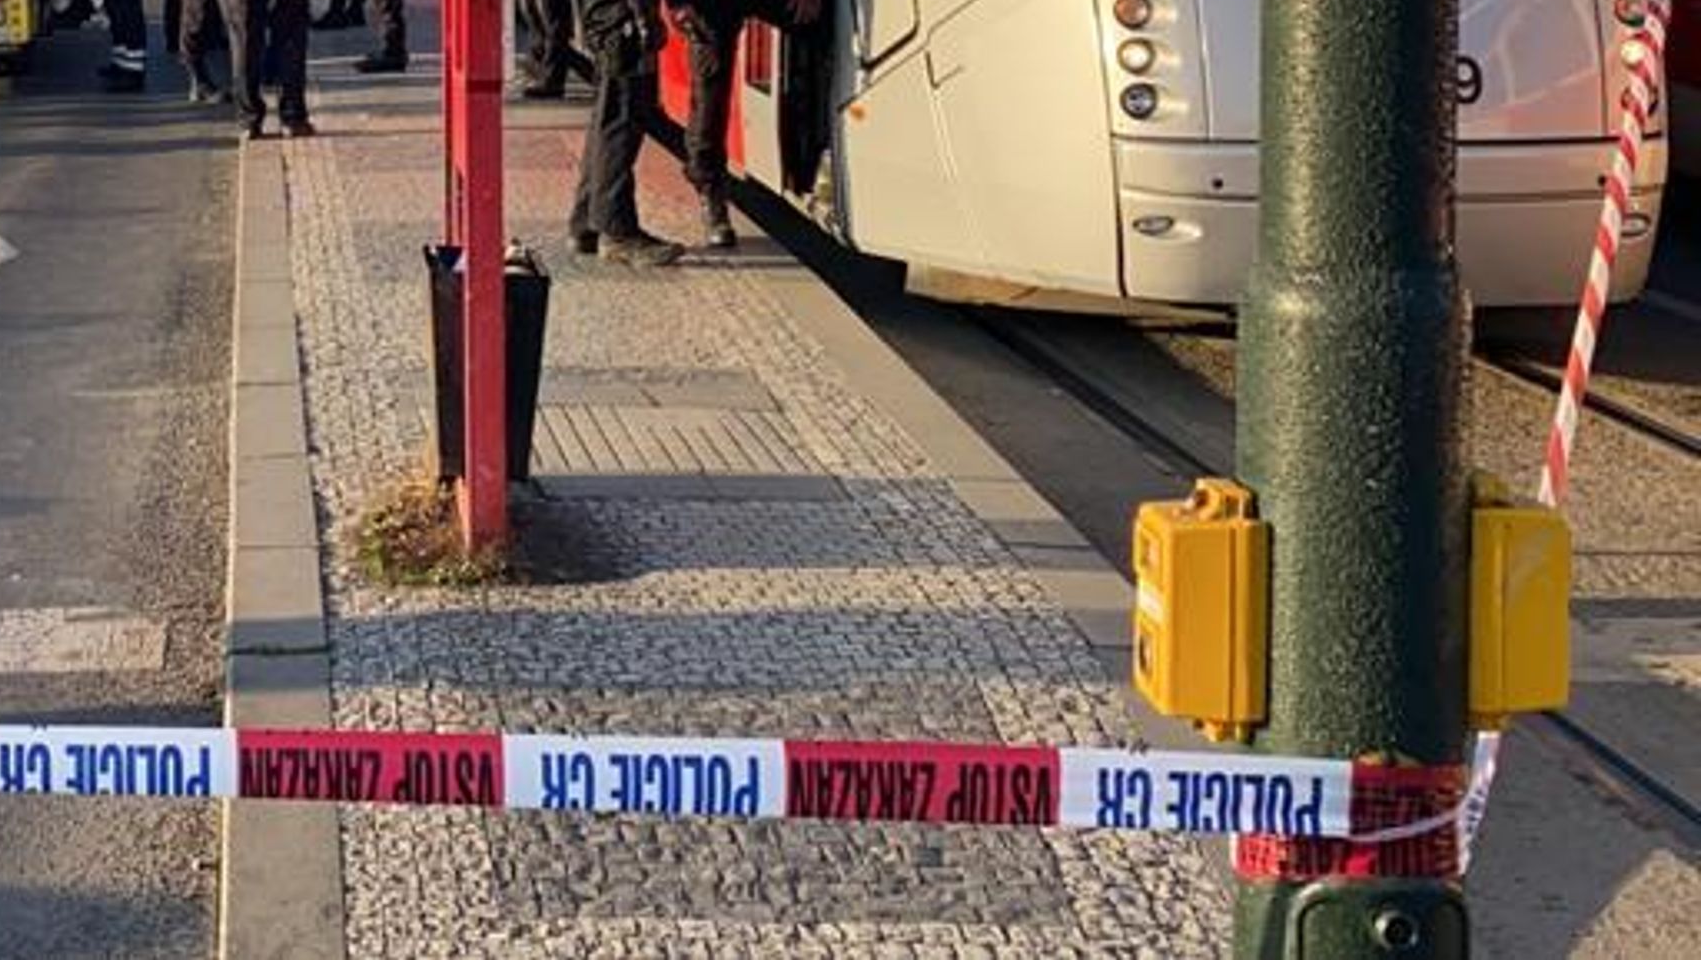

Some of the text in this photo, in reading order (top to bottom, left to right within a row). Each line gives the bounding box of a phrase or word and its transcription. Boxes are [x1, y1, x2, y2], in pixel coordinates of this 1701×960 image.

[66, 744, 210, 795] POLICIE
[610, 754, 759, 814] POLICIE
[1169, 771, 1323, 835] POLICIE
